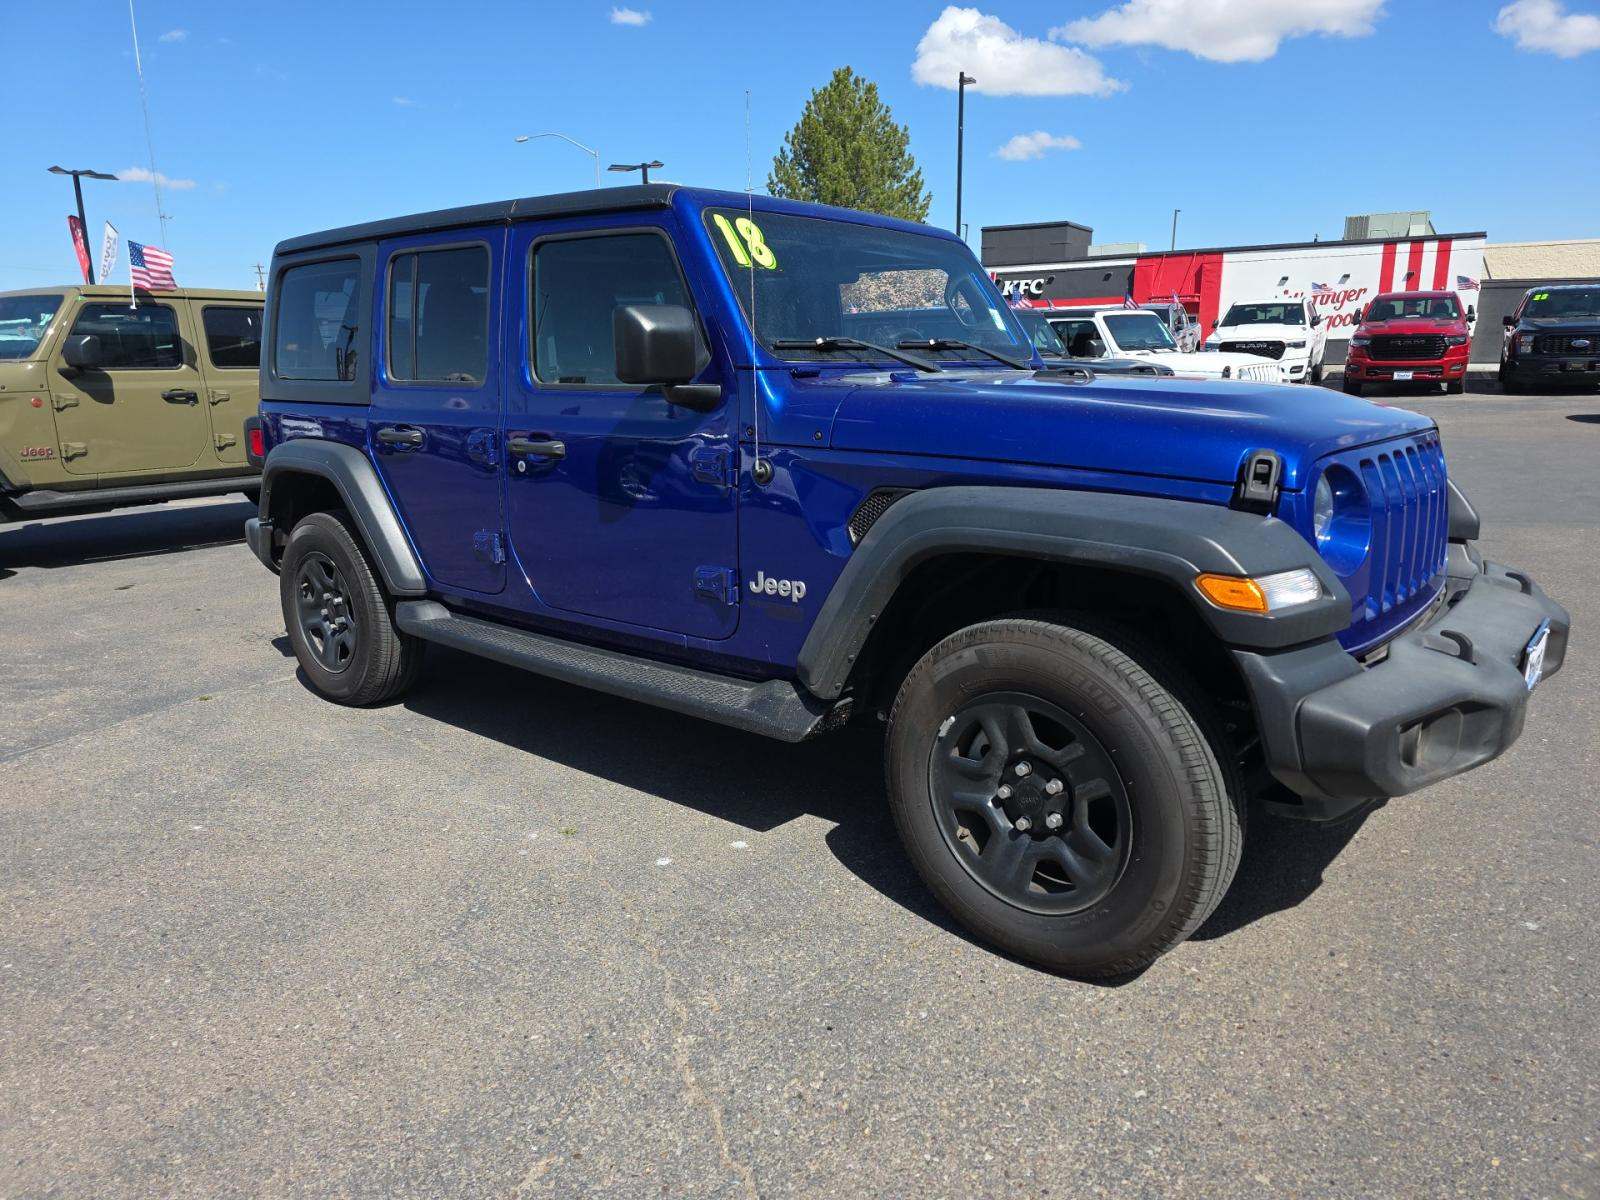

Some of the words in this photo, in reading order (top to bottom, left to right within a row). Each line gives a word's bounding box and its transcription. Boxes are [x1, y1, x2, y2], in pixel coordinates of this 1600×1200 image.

[713, 213, 777, 270] 18
[1002, 278, 1045, 296] KFC
[20, 446, 54, 458] Jeep
[749, 570, 807, 603] Jeep
